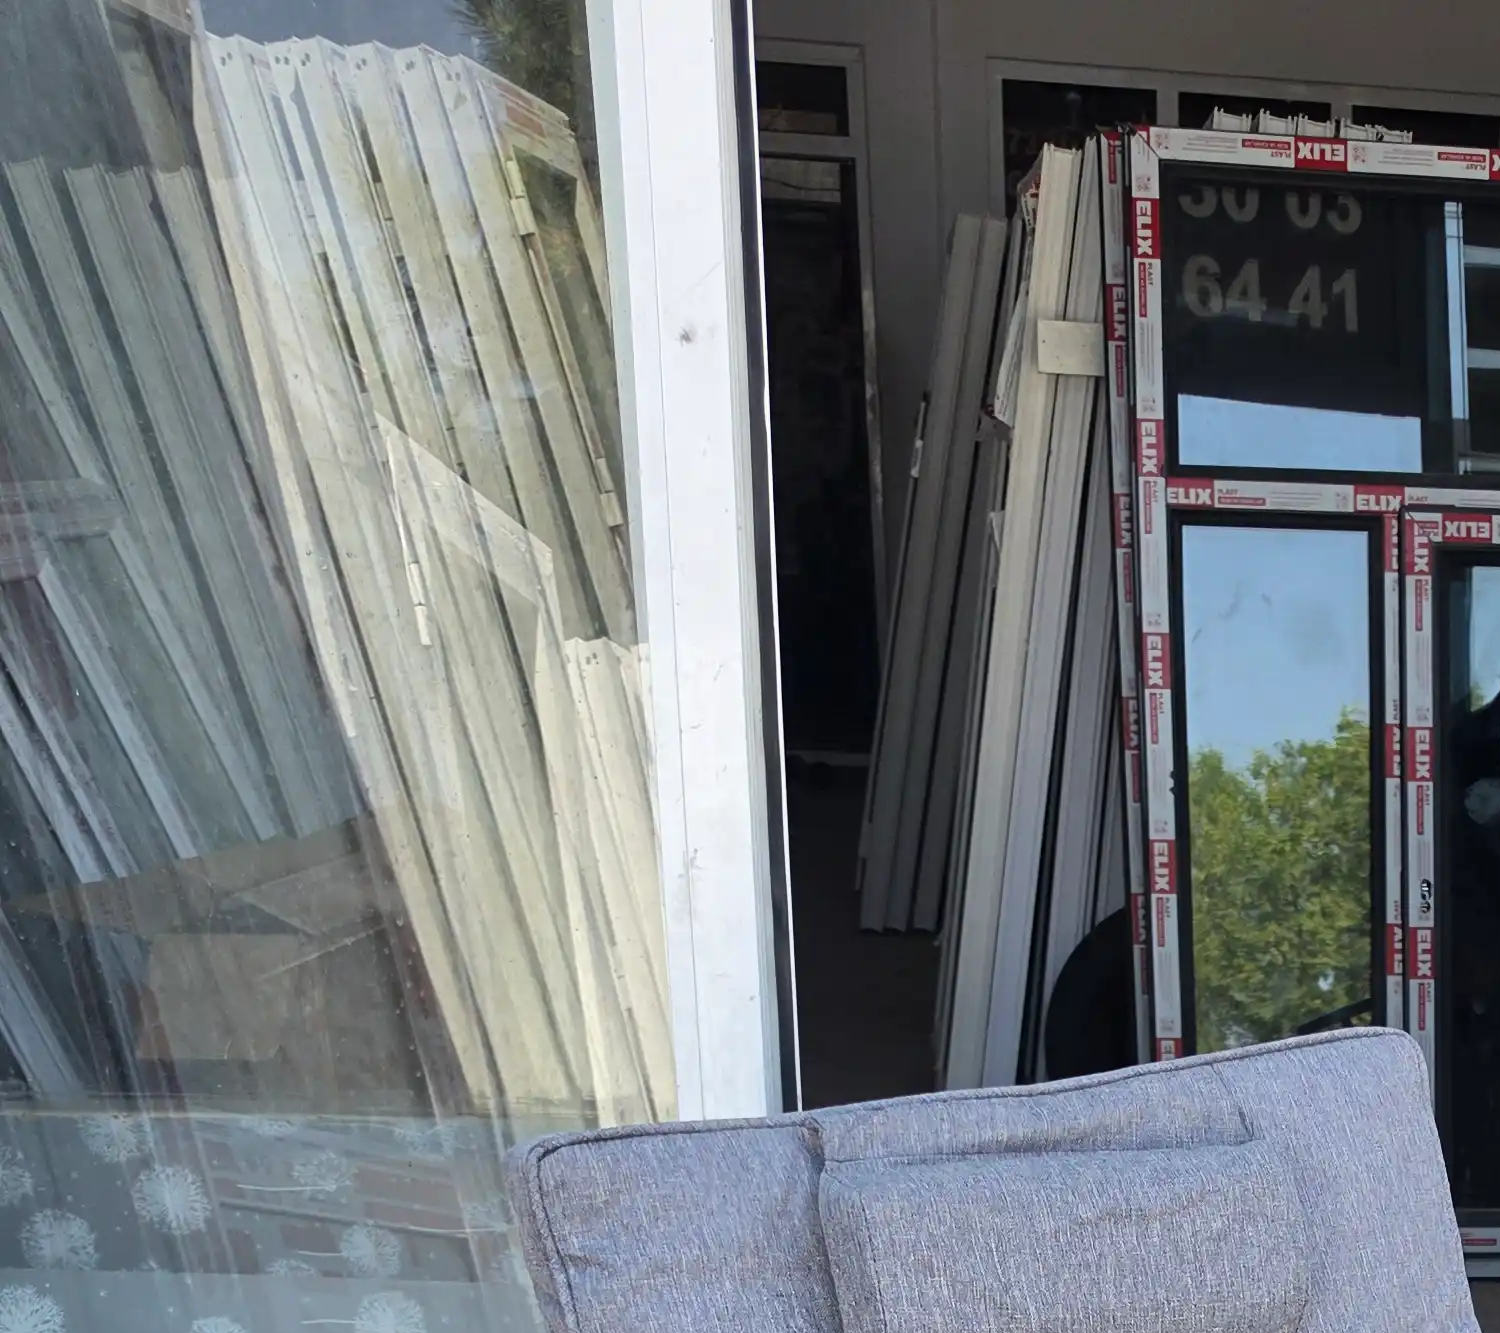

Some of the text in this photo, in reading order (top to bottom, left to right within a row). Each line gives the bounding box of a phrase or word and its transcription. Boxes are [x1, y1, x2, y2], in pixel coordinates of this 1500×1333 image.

[1271, 151, 1291, 159] PLAST
[1297, 142, 1345, 162] ELIX
[1466, 163, 1486, 171] PLAST
[1136, 200, 1153, 256] ELIX
[1181, 254, 1267, 322] 64
[1288, 263, 1359, 333] 41
[1141, 421, 1158, 475] ELIX
[1167, 487, 1212, 505] ELIX
[1356, 494, 1402, 512] ELIX
[1445, 521, 1490, 538] ELIX
[1147, 635, 1163, 687] ELIX
[1415, 729, 1430, 779] ELIX
[1153, 842, 1170, 891] ELIX
[1417, 929, 1432, 977] ELIX
